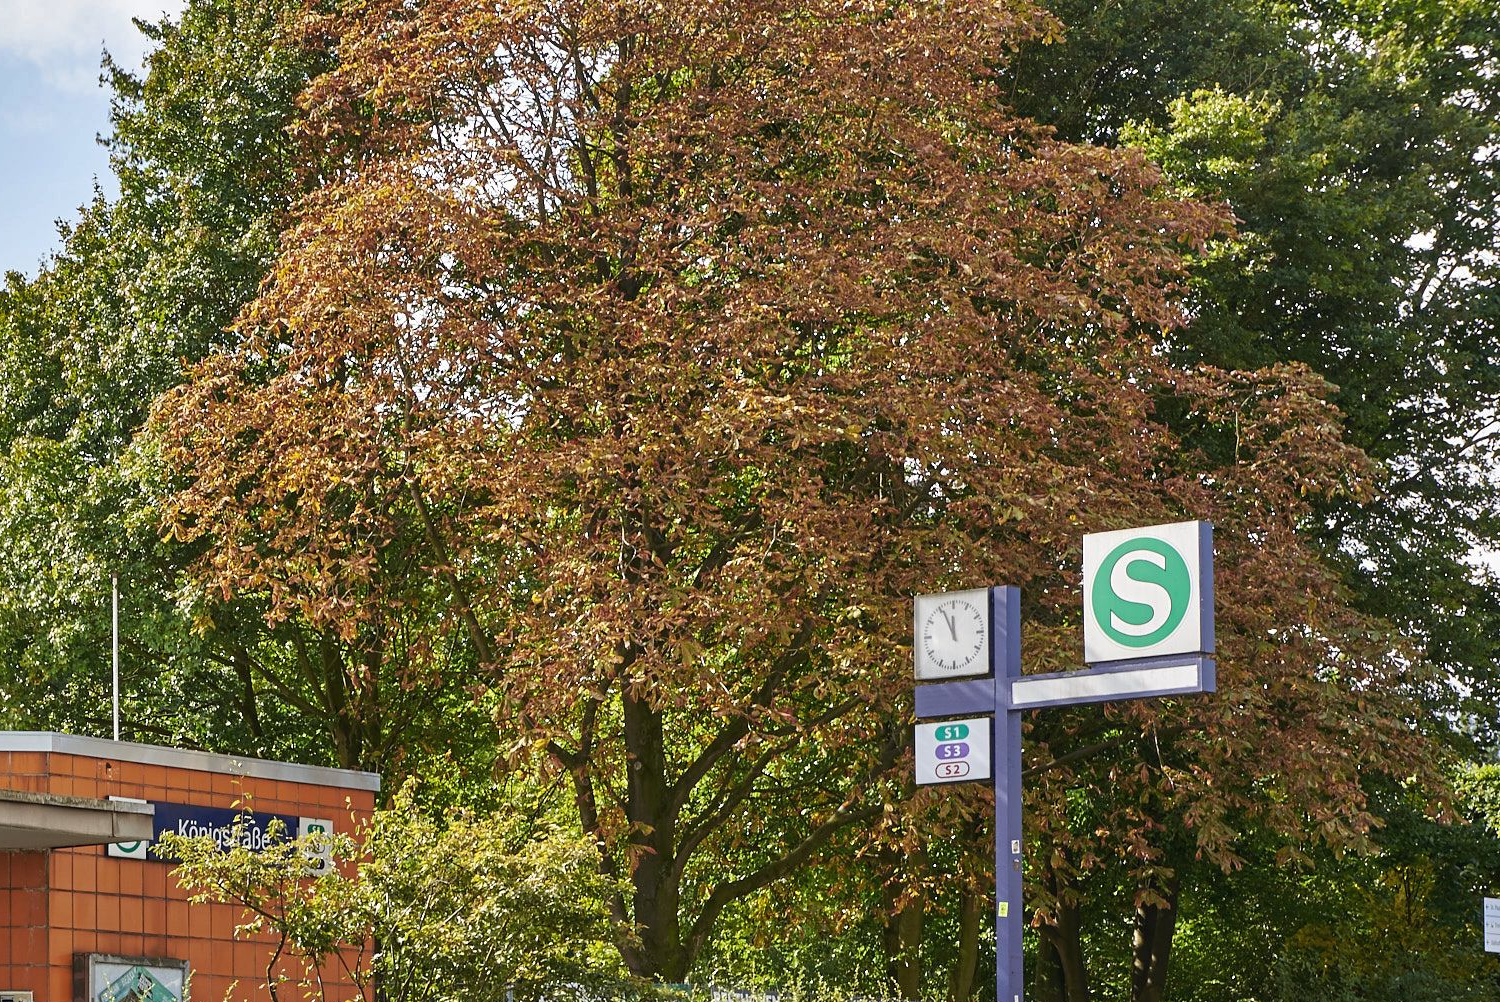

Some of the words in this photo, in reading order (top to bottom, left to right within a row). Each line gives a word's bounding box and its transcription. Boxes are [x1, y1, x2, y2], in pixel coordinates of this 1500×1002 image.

[1110, 550, 1172, 637] S
[944, 727, 960, 739] S1
[944, 745, 961, 758] S3
[945, 765, 960, 775] S2
[178, 819, 271, 851] Königsaße
